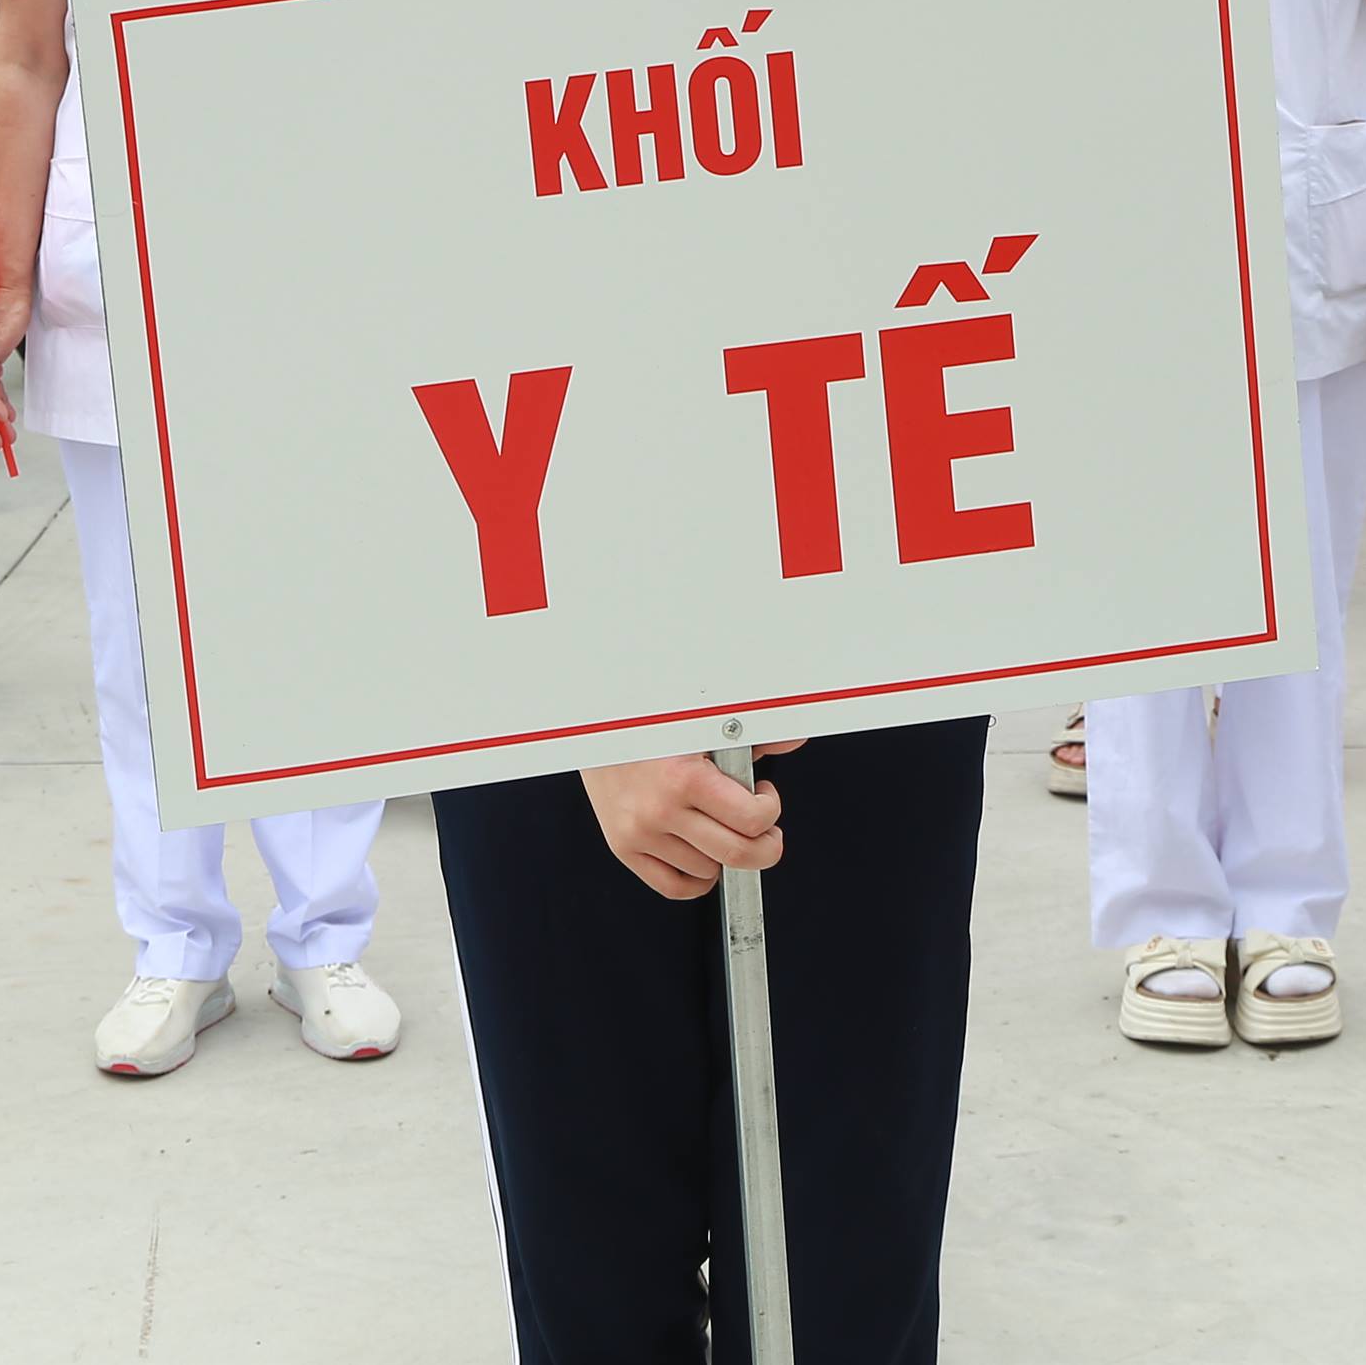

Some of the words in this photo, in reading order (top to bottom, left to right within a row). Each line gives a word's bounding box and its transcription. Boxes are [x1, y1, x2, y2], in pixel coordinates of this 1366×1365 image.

[526, 9, 803, 197] KHỐI
[412, 366, 573, 617] Y
[723, 234, 1039, 579] TẾ
